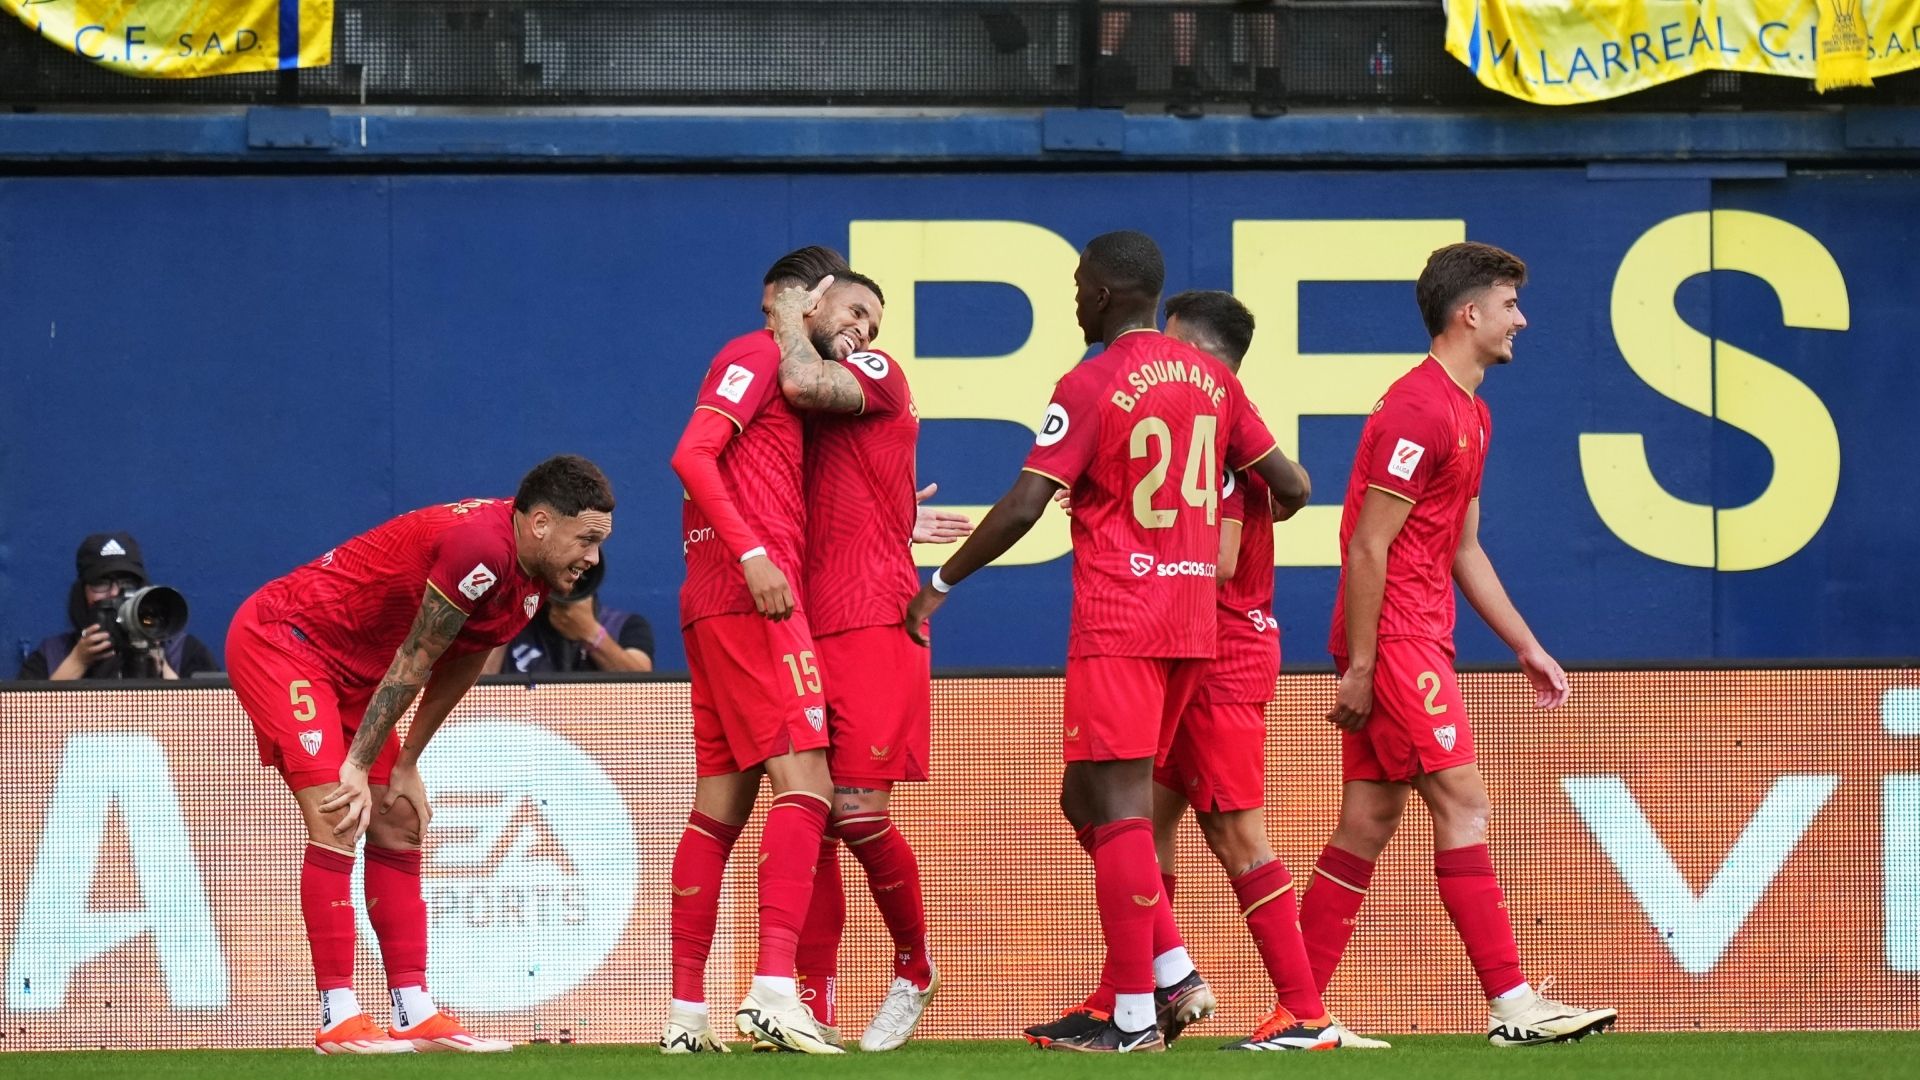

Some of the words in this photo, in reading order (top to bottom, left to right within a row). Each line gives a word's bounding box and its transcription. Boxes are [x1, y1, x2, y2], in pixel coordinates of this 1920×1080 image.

[75, 25, 148, 61] C.F.
[178, 29, 263, 57] S.A.D.
[1487, 16, 1740, 84] VILARREAL
[1111, 360, 1226, 413] B.SOUMARÉ
[1130, 414, 1219, 528] 24
[782, 650, 823, 697] 15
[1416, 671, 1448, 717] 2
[289, 680, 316, 722] 5
[430, 884, 586, 928] PORTS
